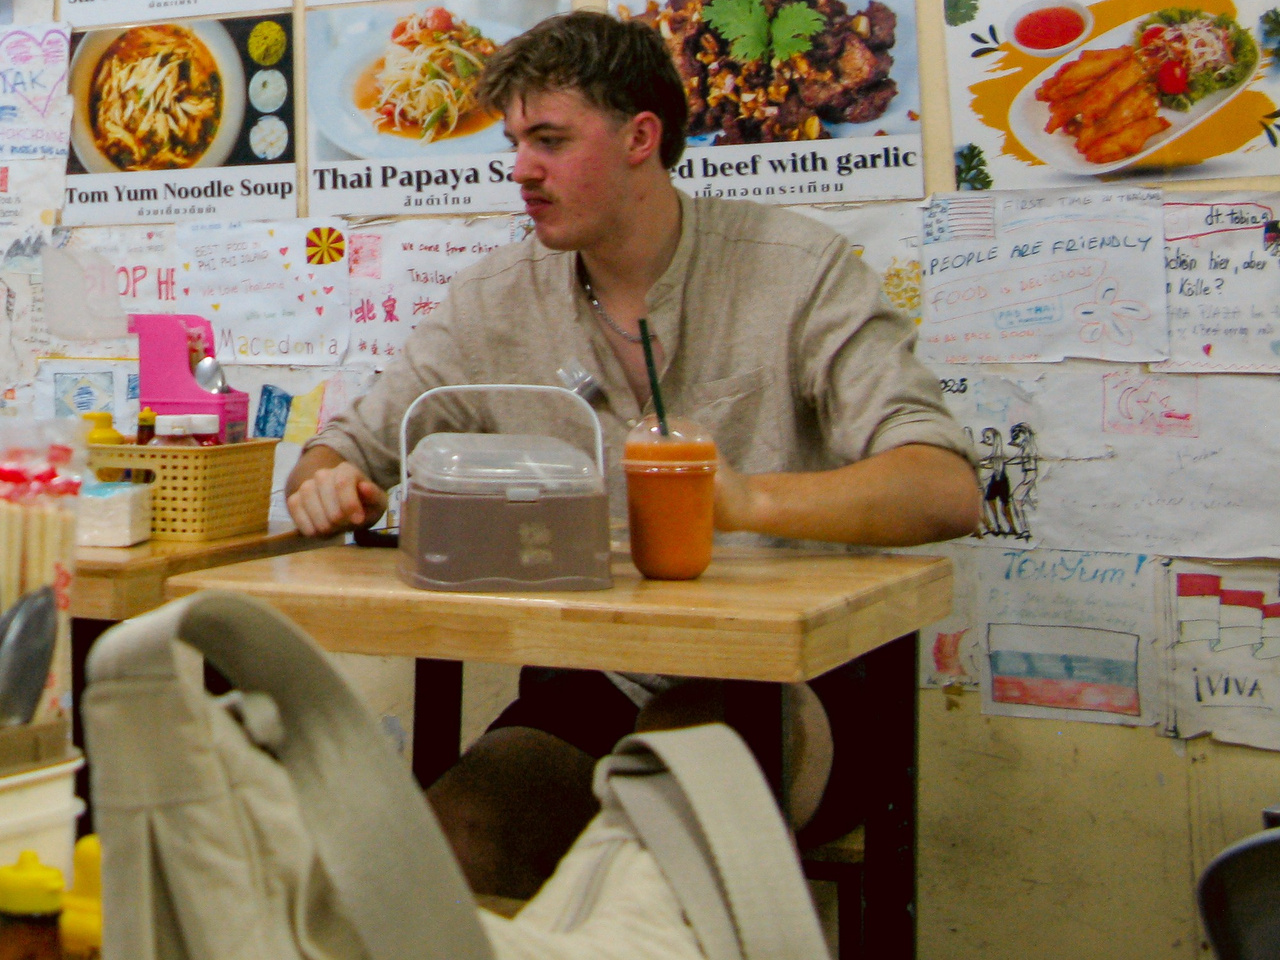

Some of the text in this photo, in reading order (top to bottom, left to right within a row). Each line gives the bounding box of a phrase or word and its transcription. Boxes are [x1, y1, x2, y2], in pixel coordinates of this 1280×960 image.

[313, 166, 372, 191] Thai
[380, 163, 480, 193] Papaya
[702, 154, 762, 179] beef
[768, 151, 828, 175] with
[837, 145, 917, 176] garlic
[65, 177, 294, 204] Tom Yum Noodle Soup
[929, 246, 998, 276] PEOPLE
[1010, 240, 1044, 259] ARE
